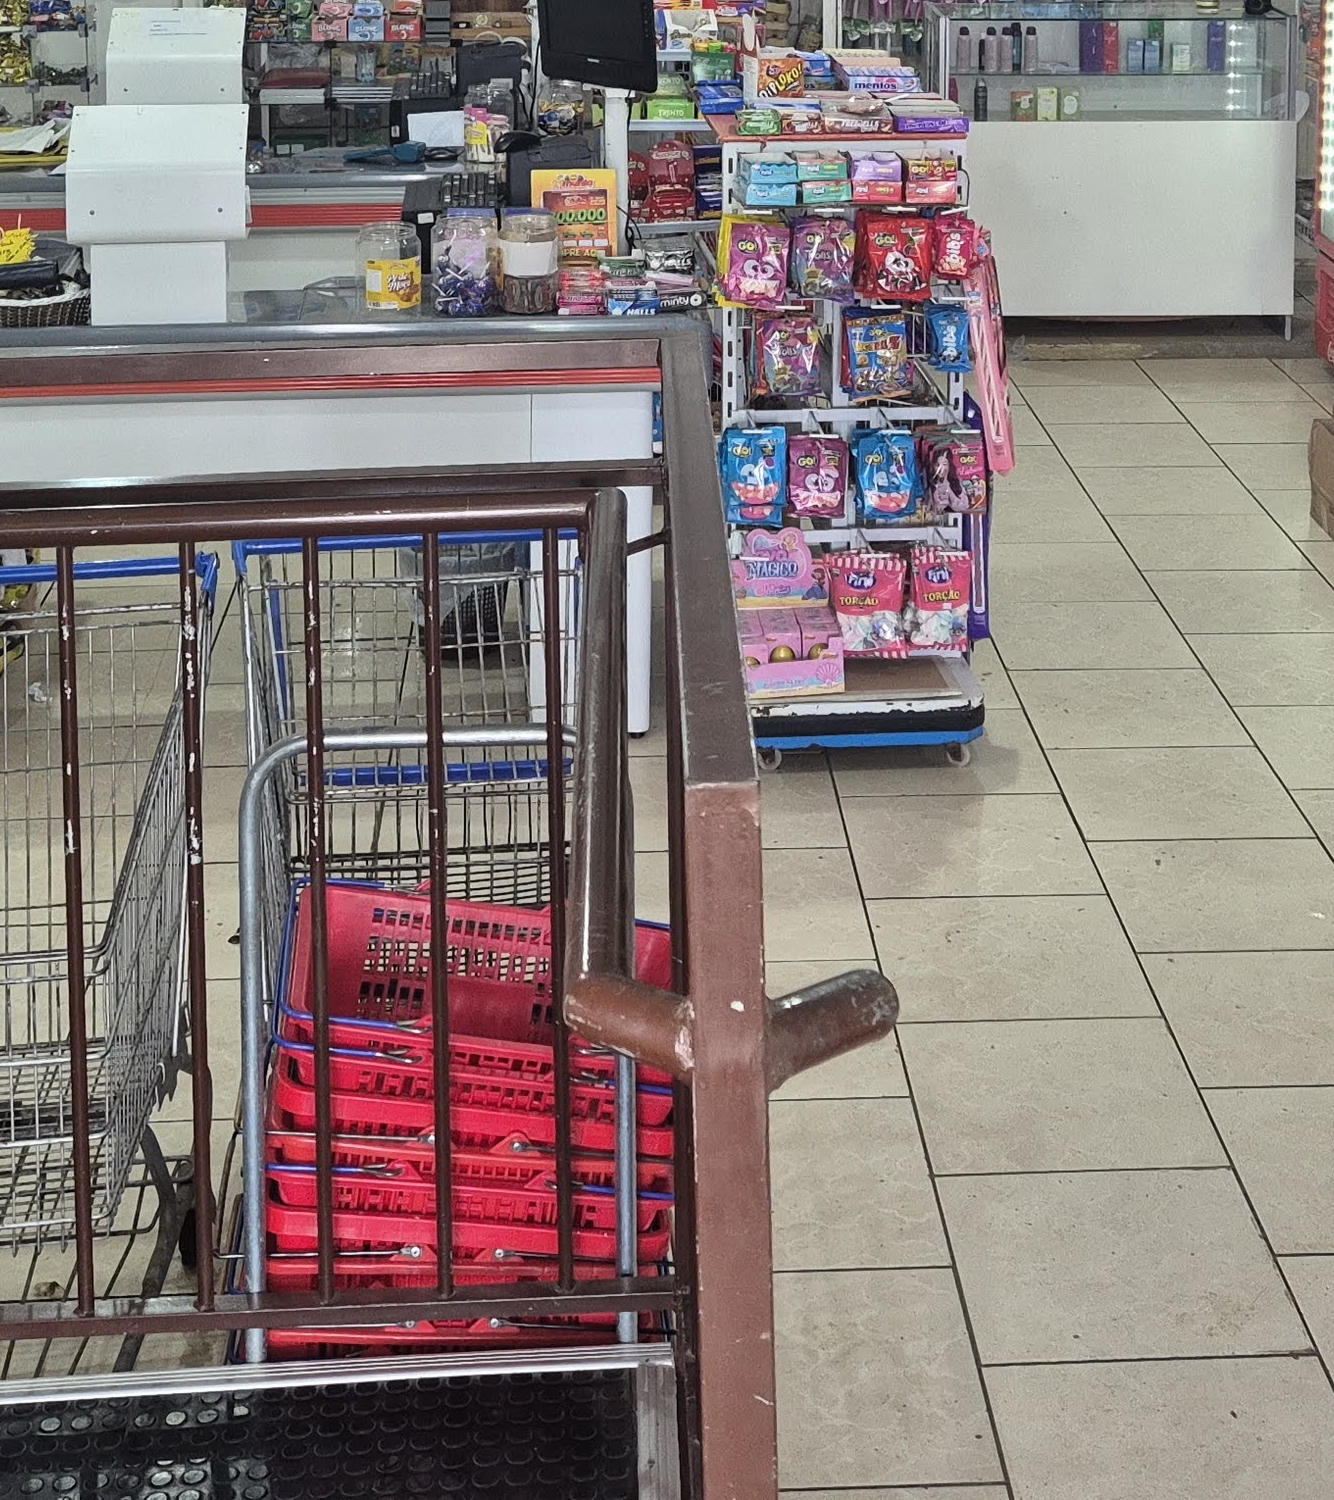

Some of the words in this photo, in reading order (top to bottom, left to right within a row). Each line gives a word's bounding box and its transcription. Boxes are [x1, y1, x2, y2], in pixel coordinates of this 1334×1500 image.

[854, 78, 897, 90] mentos
[658, 109, 685, 117] TRENTO
[554, 208, 606, 222] 00.000
[738, 240, 758, 251] GO!
[875, 234, 898, 246] GO!
[660, 297, 689, 308] minty
[798, 456, 817, 467] GO!
